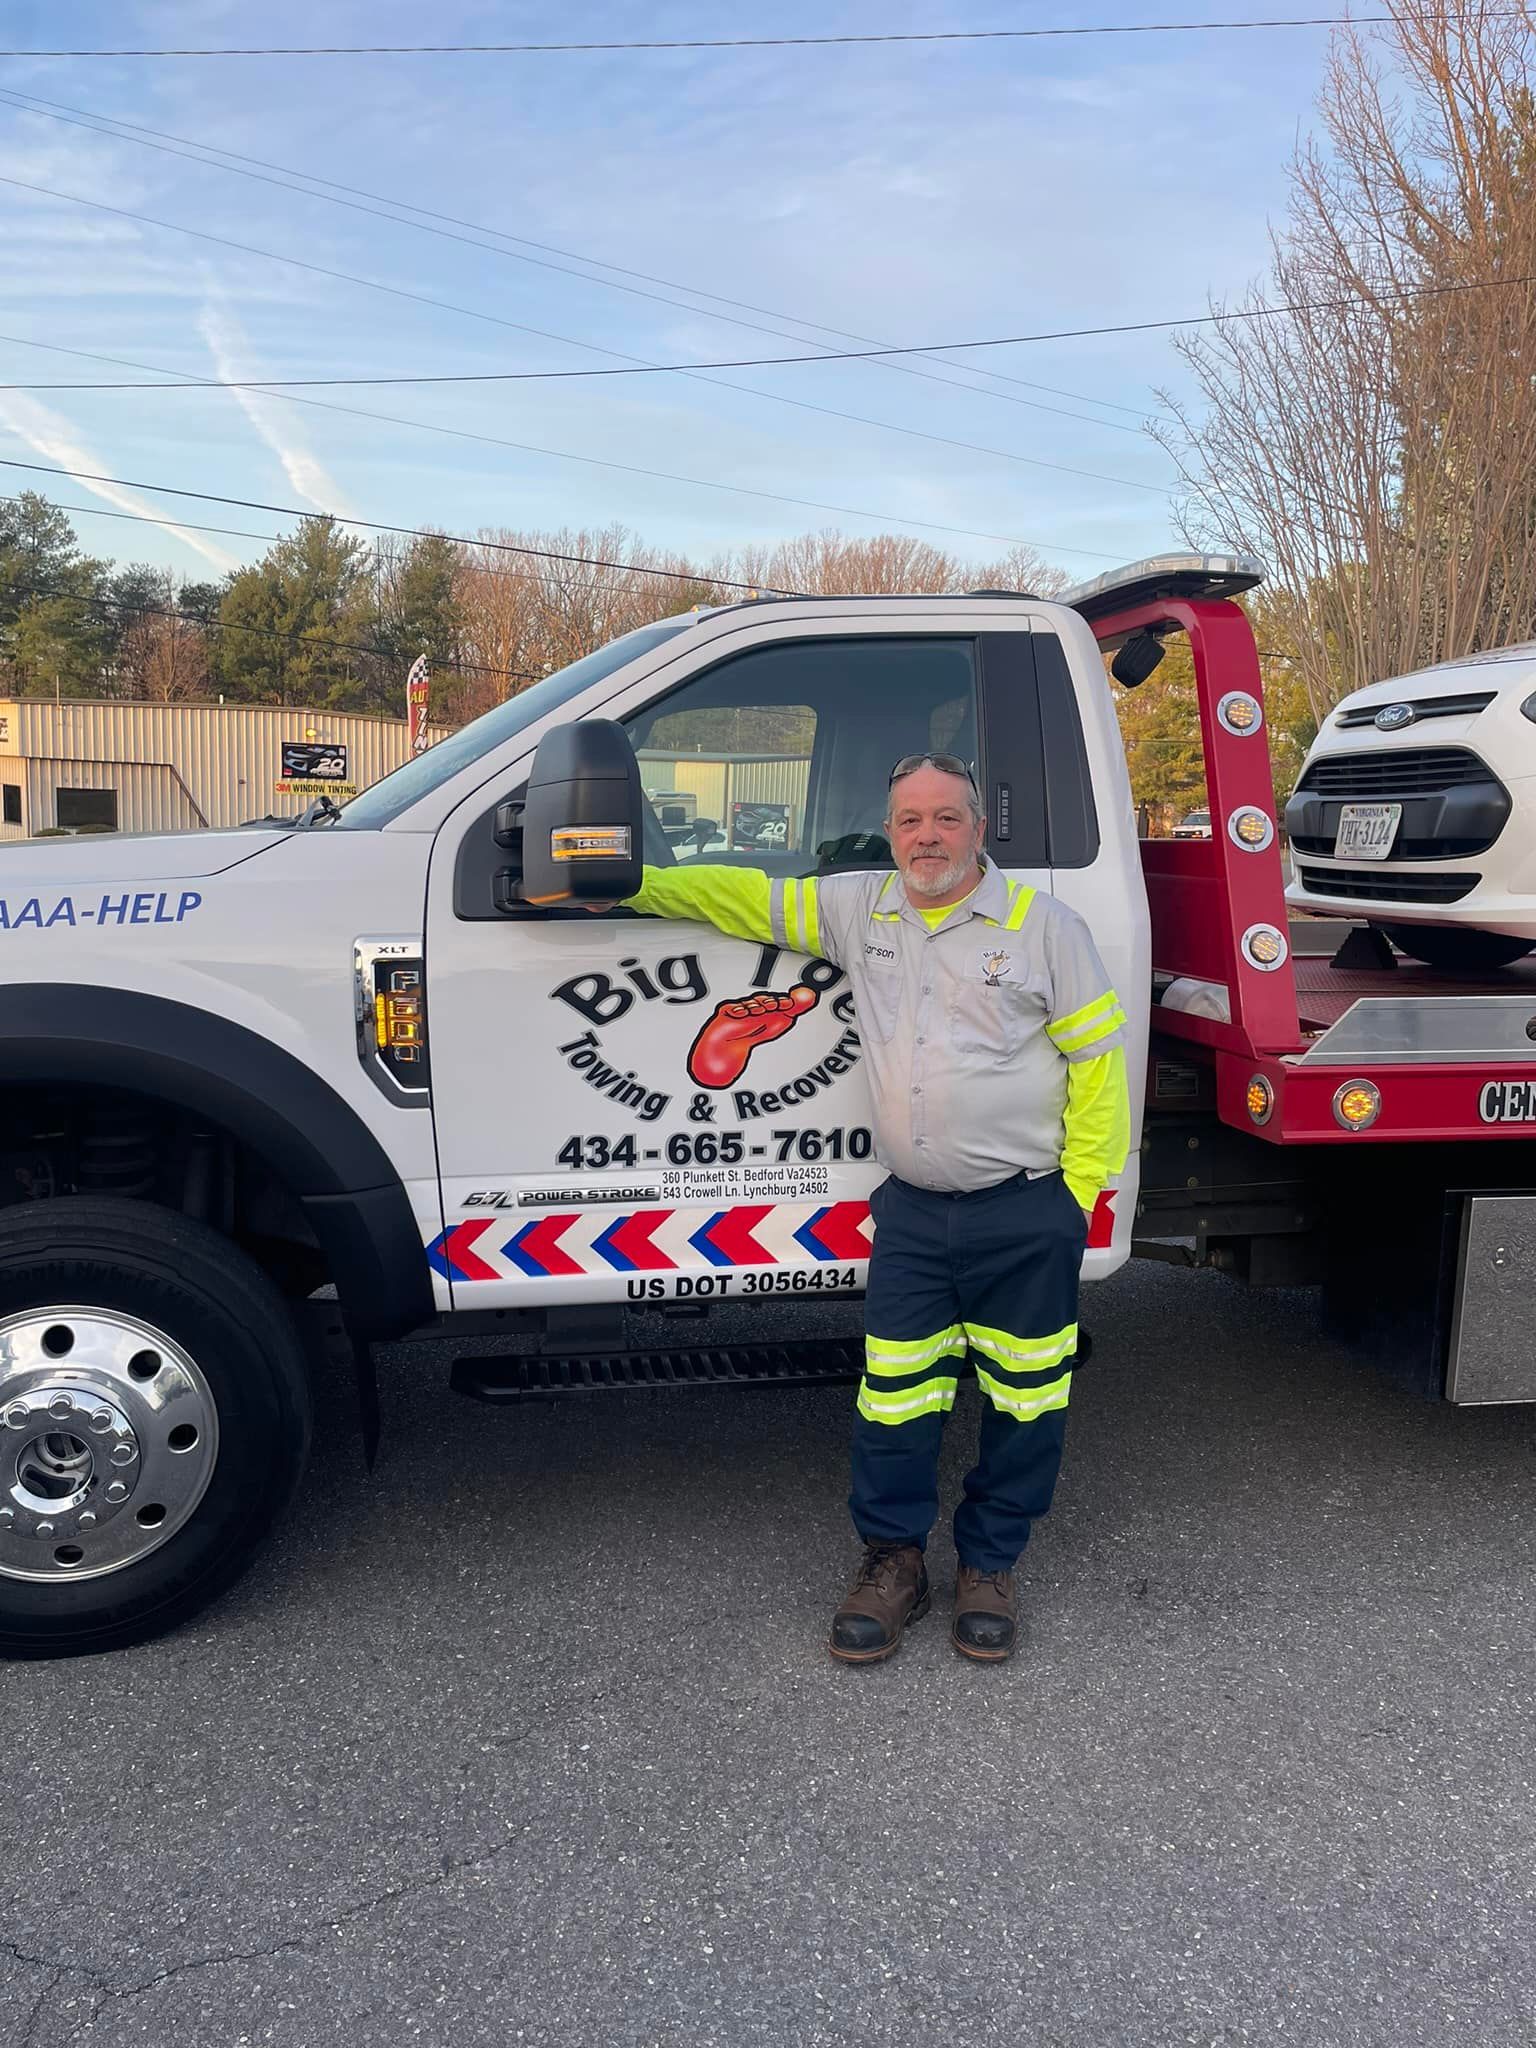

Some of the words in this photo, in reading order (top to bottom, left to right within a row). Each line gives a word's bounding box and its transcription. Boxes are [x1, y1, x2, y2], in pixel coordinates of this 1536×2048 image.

[410, 690, 428, 704] AU
[276, 783, 291, 793] 3M
[293, 784, 325, 793] WINDOW
[328, 785, 357, 795] TINTING
[864, 943, 895, 960] arson
[549, 952, 711, 1027] Big
[557, 1029, 673, 1123] Towing
[687, 1092, 717, 1123] &
[662, 1172, 680, 1184] 360
[683, 1170, 725, 1183] Plunkett
[728, 1170, 741, 1182] St.
[744, 1168, 784, 1181] Bedford
[523, 1190, 583, 1201] POWER
[588, 1187, 656, 1199] STROKE
[663, 1187, 681, 1199] 543
[684, 1185, 722, 1198] Crowell
[725, 1185, 741, 1196] Ln.
[743, 1183, 797, 1199] Lynchburg
[800, 1182, 828, 1194] 24502
[627, 1279, 665, 1299] US
[676, 1275, 733, 1296] DOT
[742, 1267, 857, 1293] 3056434
